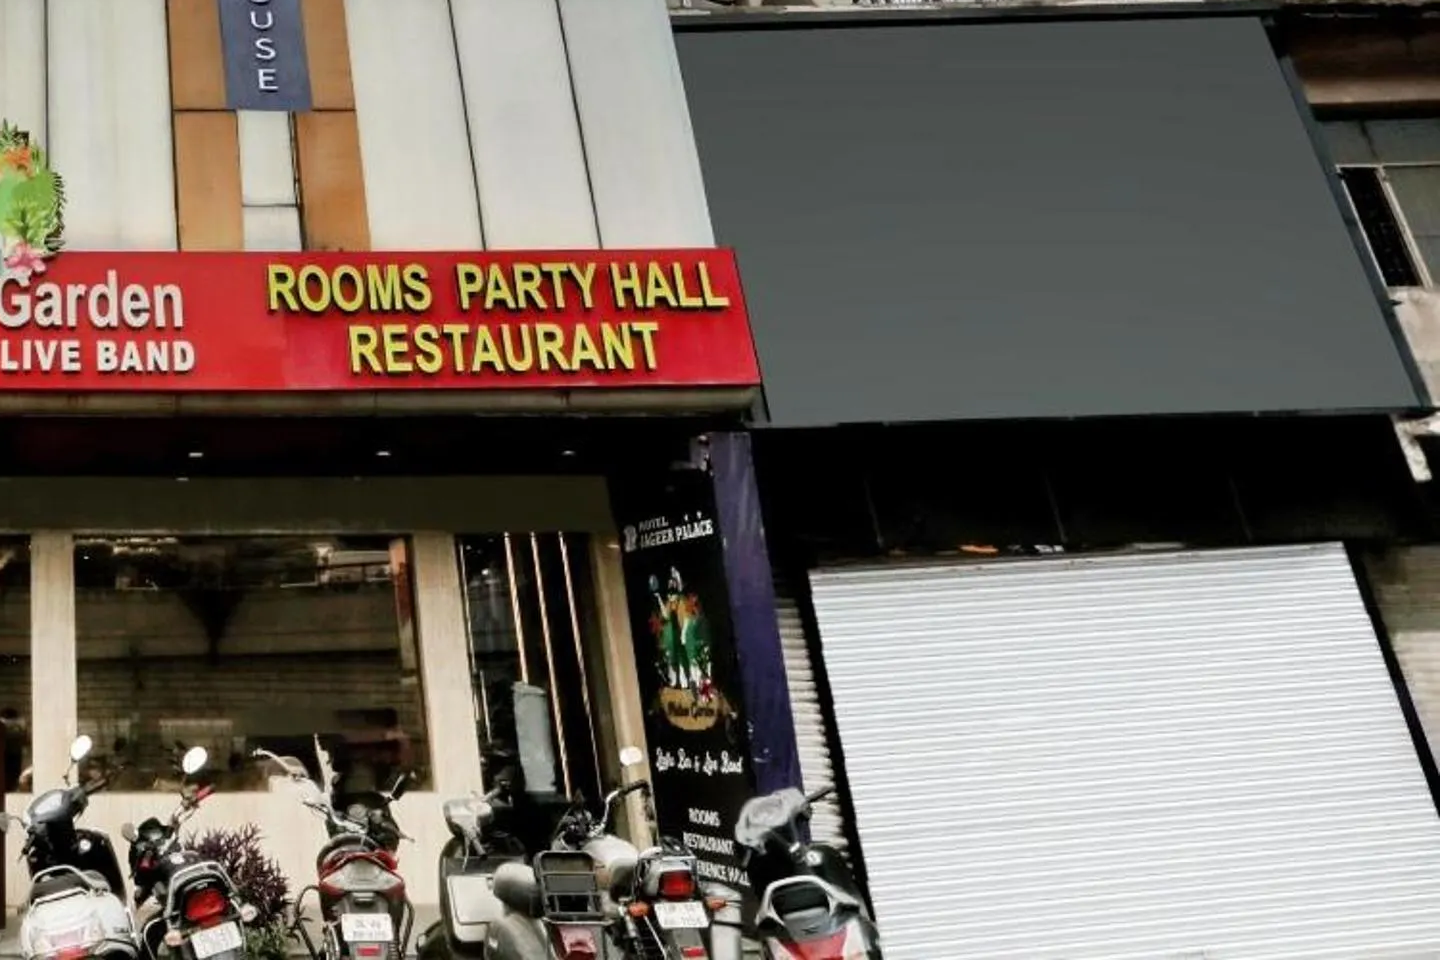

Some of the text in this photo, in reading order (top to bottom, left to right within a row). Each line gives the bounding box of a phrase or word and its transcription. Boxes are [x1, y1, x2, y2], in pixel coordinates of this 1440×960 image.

[267, 260, 730, 312] ROOMS PARTY HALL
[0, 339, 82, 373] LIVE
[96, 340, 196, 373] BAND
[348, 321, 659, 374] RESTAURANT
[688, 807, 721, 828] ROOMS
[682, 831, 735, 856] RESTAURANT
